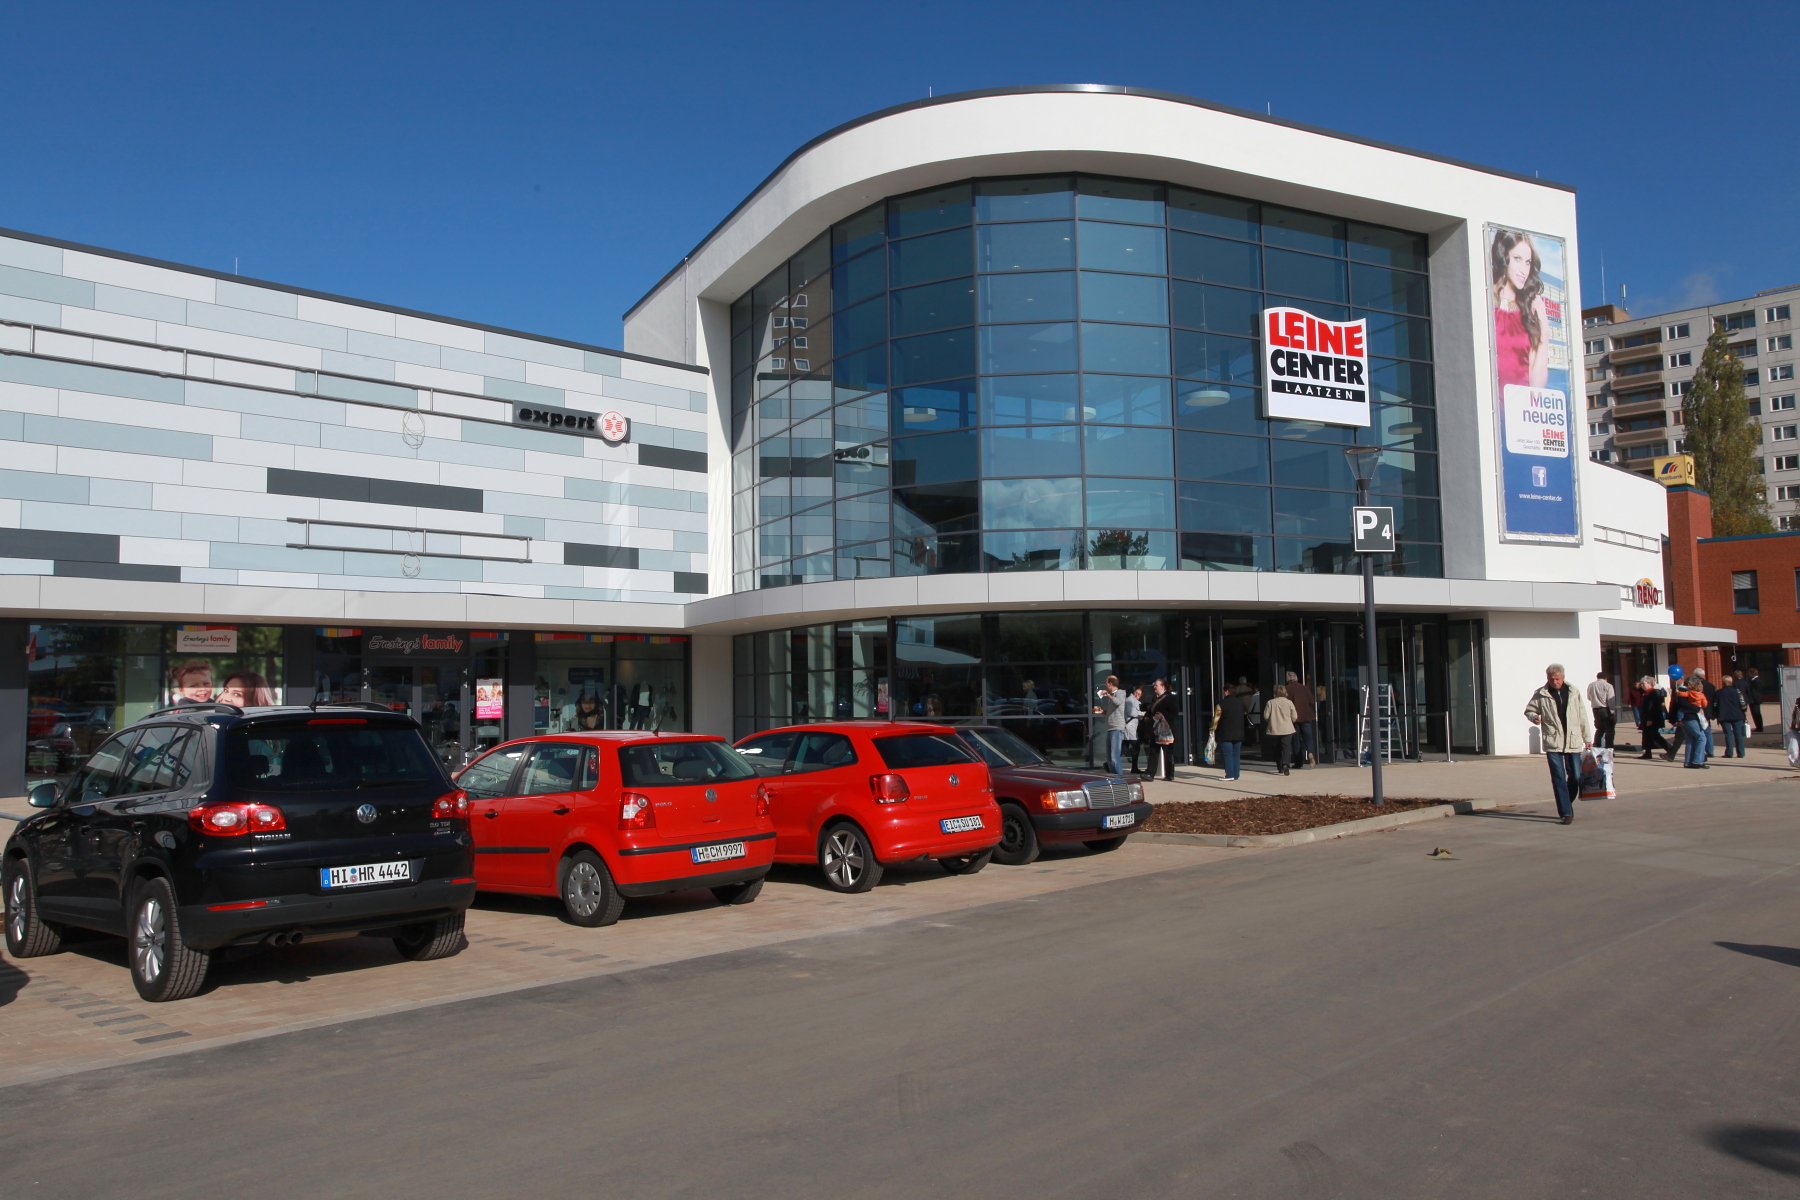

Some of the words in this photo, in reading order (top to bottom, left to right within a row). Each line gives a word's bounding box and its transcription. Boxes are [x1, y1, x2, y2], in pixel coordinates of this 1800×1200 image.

[1269, 312, 1364, 358] LEINE
[1270, 349, 1365, 386] CENTER
[1285, 383, 1353, 400] LAATZEN
[1529, 390, 1564, 410] Mein
[519, 408, 595, 431] expert
[1522, 409, 1565, 426] neues
[1542, 429, 1565, 440] LEINE
[1543, 439, 1565, 447] CENTER
[1519, 494, 1562, 502] www.leine-center.de
[1356, 510, 1378, 540] P
[1381, 524, 1391, 540] 4
[1637, 585, 1658, 605] RENO
[210, 635, 231, 643] family
[369, 636, 420, 654] Ernsting's
[422, 634, 463, 652] family
[698, 849, 705, 860] H
[710, 846, 722, 858] CM
[723, 843, 743, 856] 9997
[331, 869, 348, 884] HI
[359, 866, 375, 881] HR
[378, 863, 409, 879] 4442
